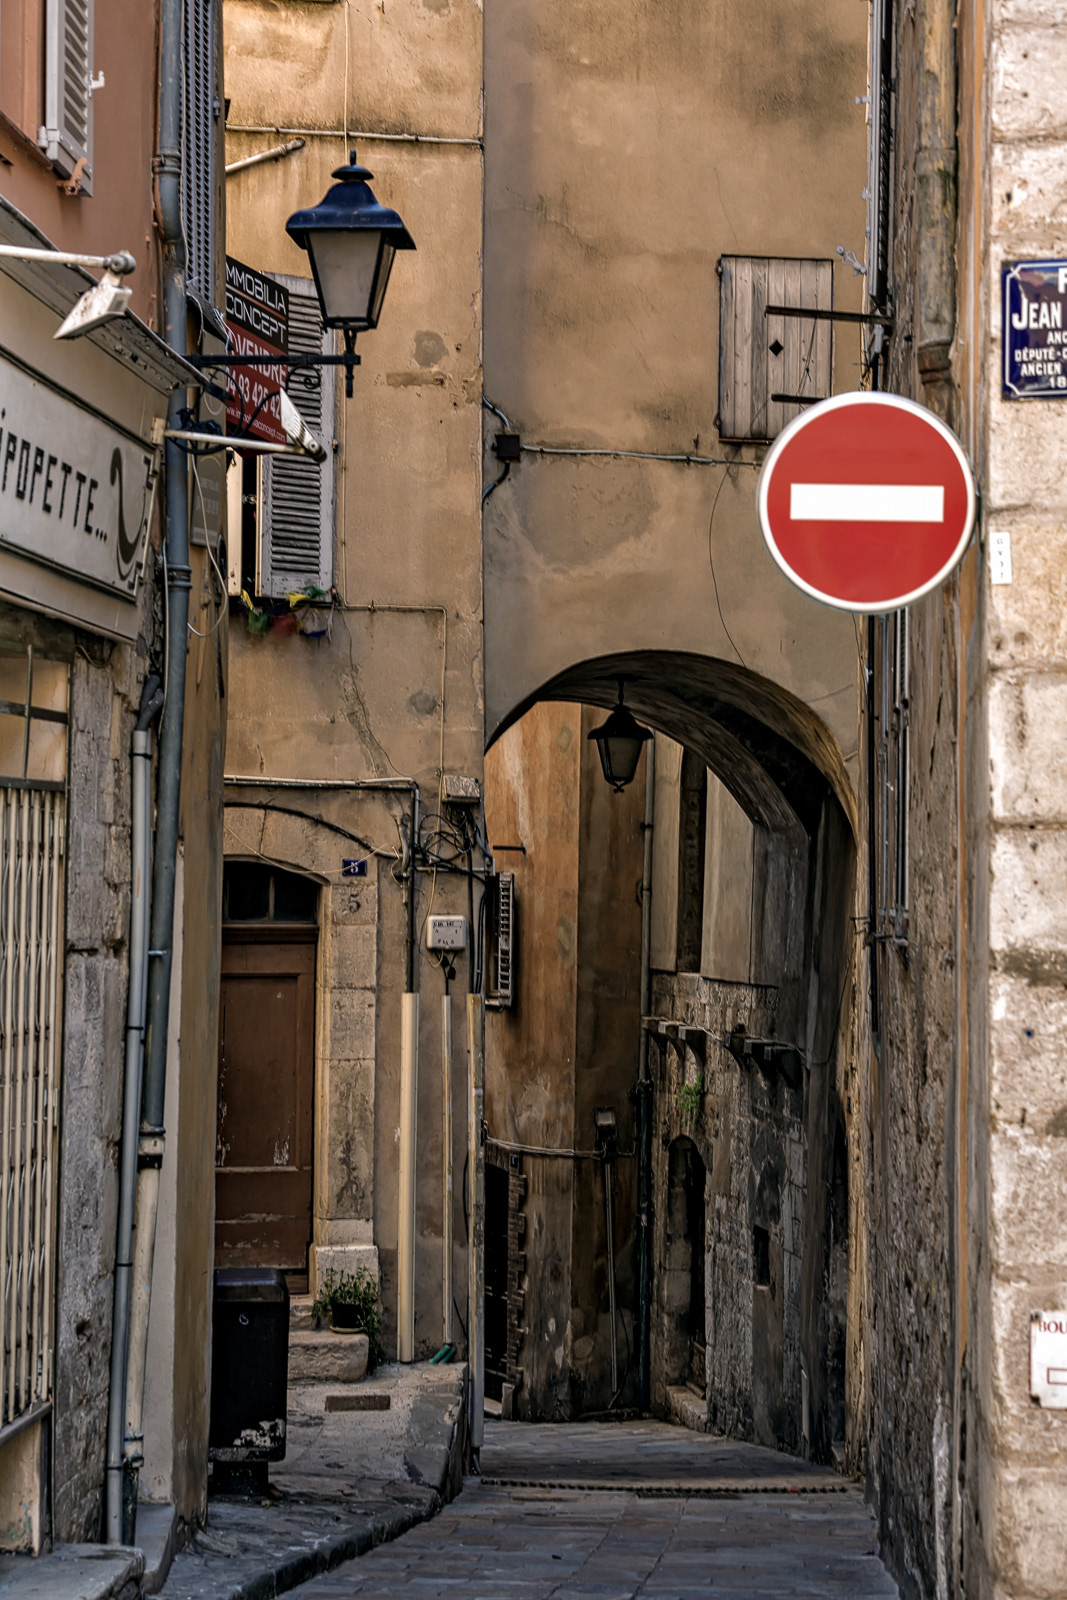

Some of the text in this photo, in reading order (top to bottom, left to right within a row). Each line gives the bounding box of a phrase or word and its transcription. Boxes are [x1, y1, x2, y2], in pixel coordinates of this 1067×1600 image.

[225, 261, 287, 315] MMOBILIA
[225, 291, 286, 344] CONCEPT
[1011, 296, 1062, 330] JEAN
[1046, 330, 1067, 345] ANC
[1020, 362, 1061, 376] ANCIEN
[1048, 375, 1067, 389] 18
[270, 393, 281, 420] 42
[348, 893, 361, 913] 5
[1038, 1320, 1067, 1334] BOU
